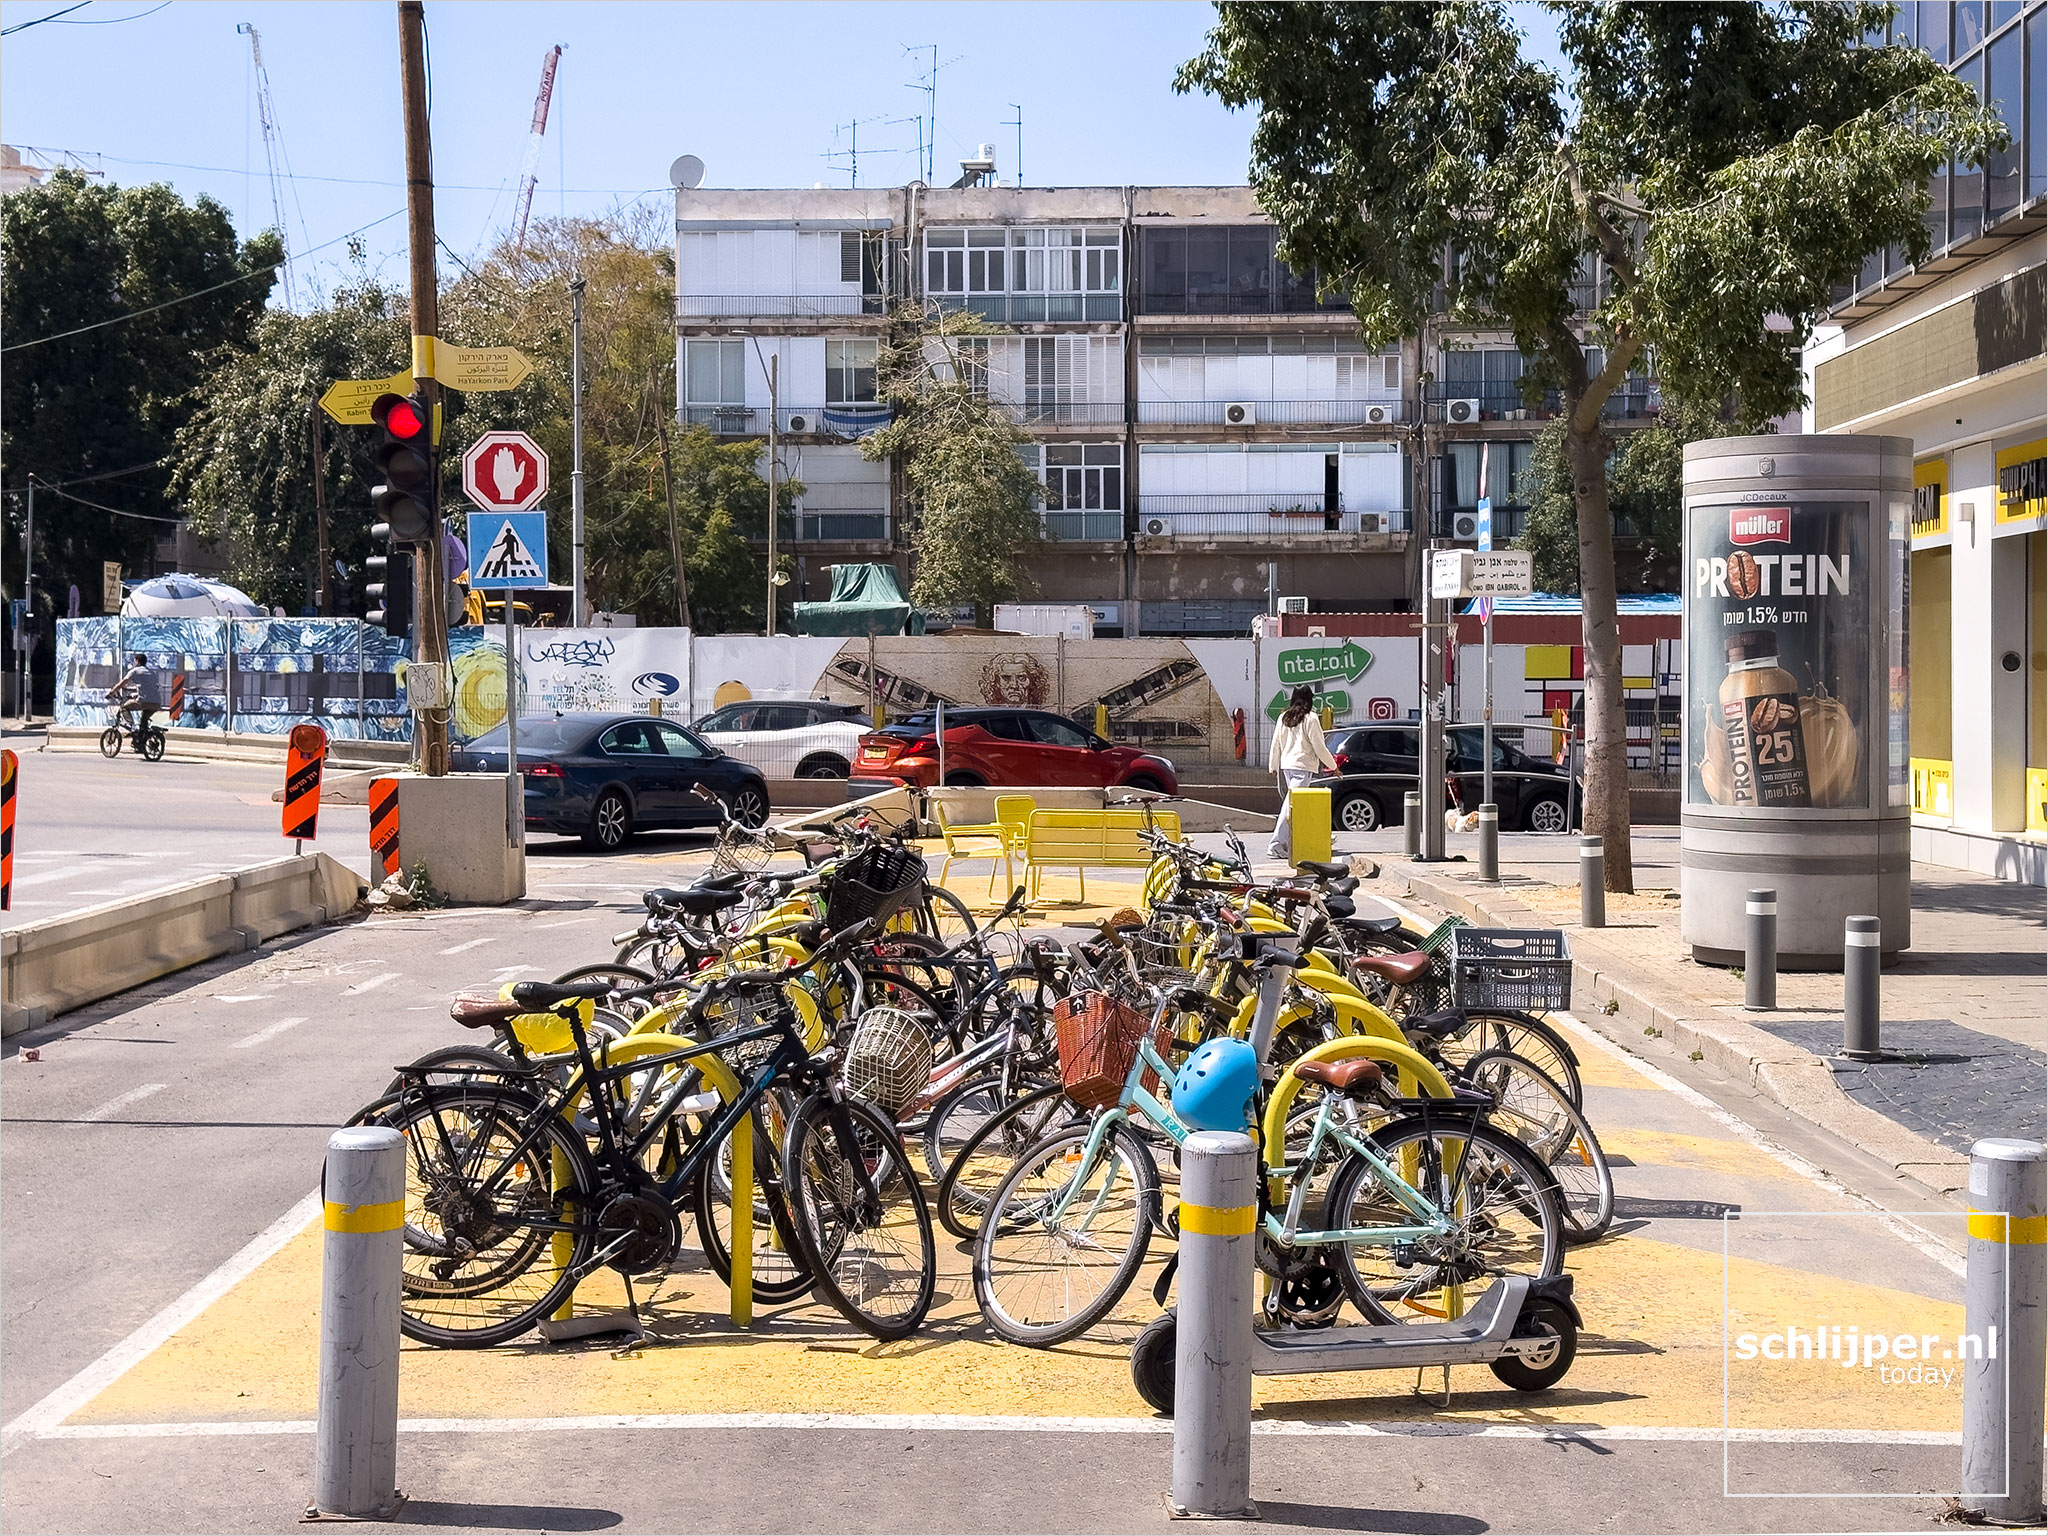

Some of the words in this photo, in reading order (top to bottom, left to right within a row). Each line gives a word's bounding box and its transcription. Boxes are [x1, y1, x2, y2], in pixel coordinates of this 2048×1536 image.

[541, 71, 552, 102] POTAIN
[458, 354, 484, 363] הירקון
[486, 354, 509, 362] פארק
[356, 384, 372, 394] רבין
[373, 383, 391, 391] כיכר
[1740, 493, 1788, 502] JCDecaux
[1735, 515, 1784, 536] müller
[1722, 610, 1745, 626] שומן
[1746, 606, 1778, 624] 1.5%
[1783, 609, 1808, 624] חדש
[1284, 651, 1357, 675] nta.co.il
[1755, 730, 1794, 765] 25
[1725, 717, 1752, 802] PROTEIN
